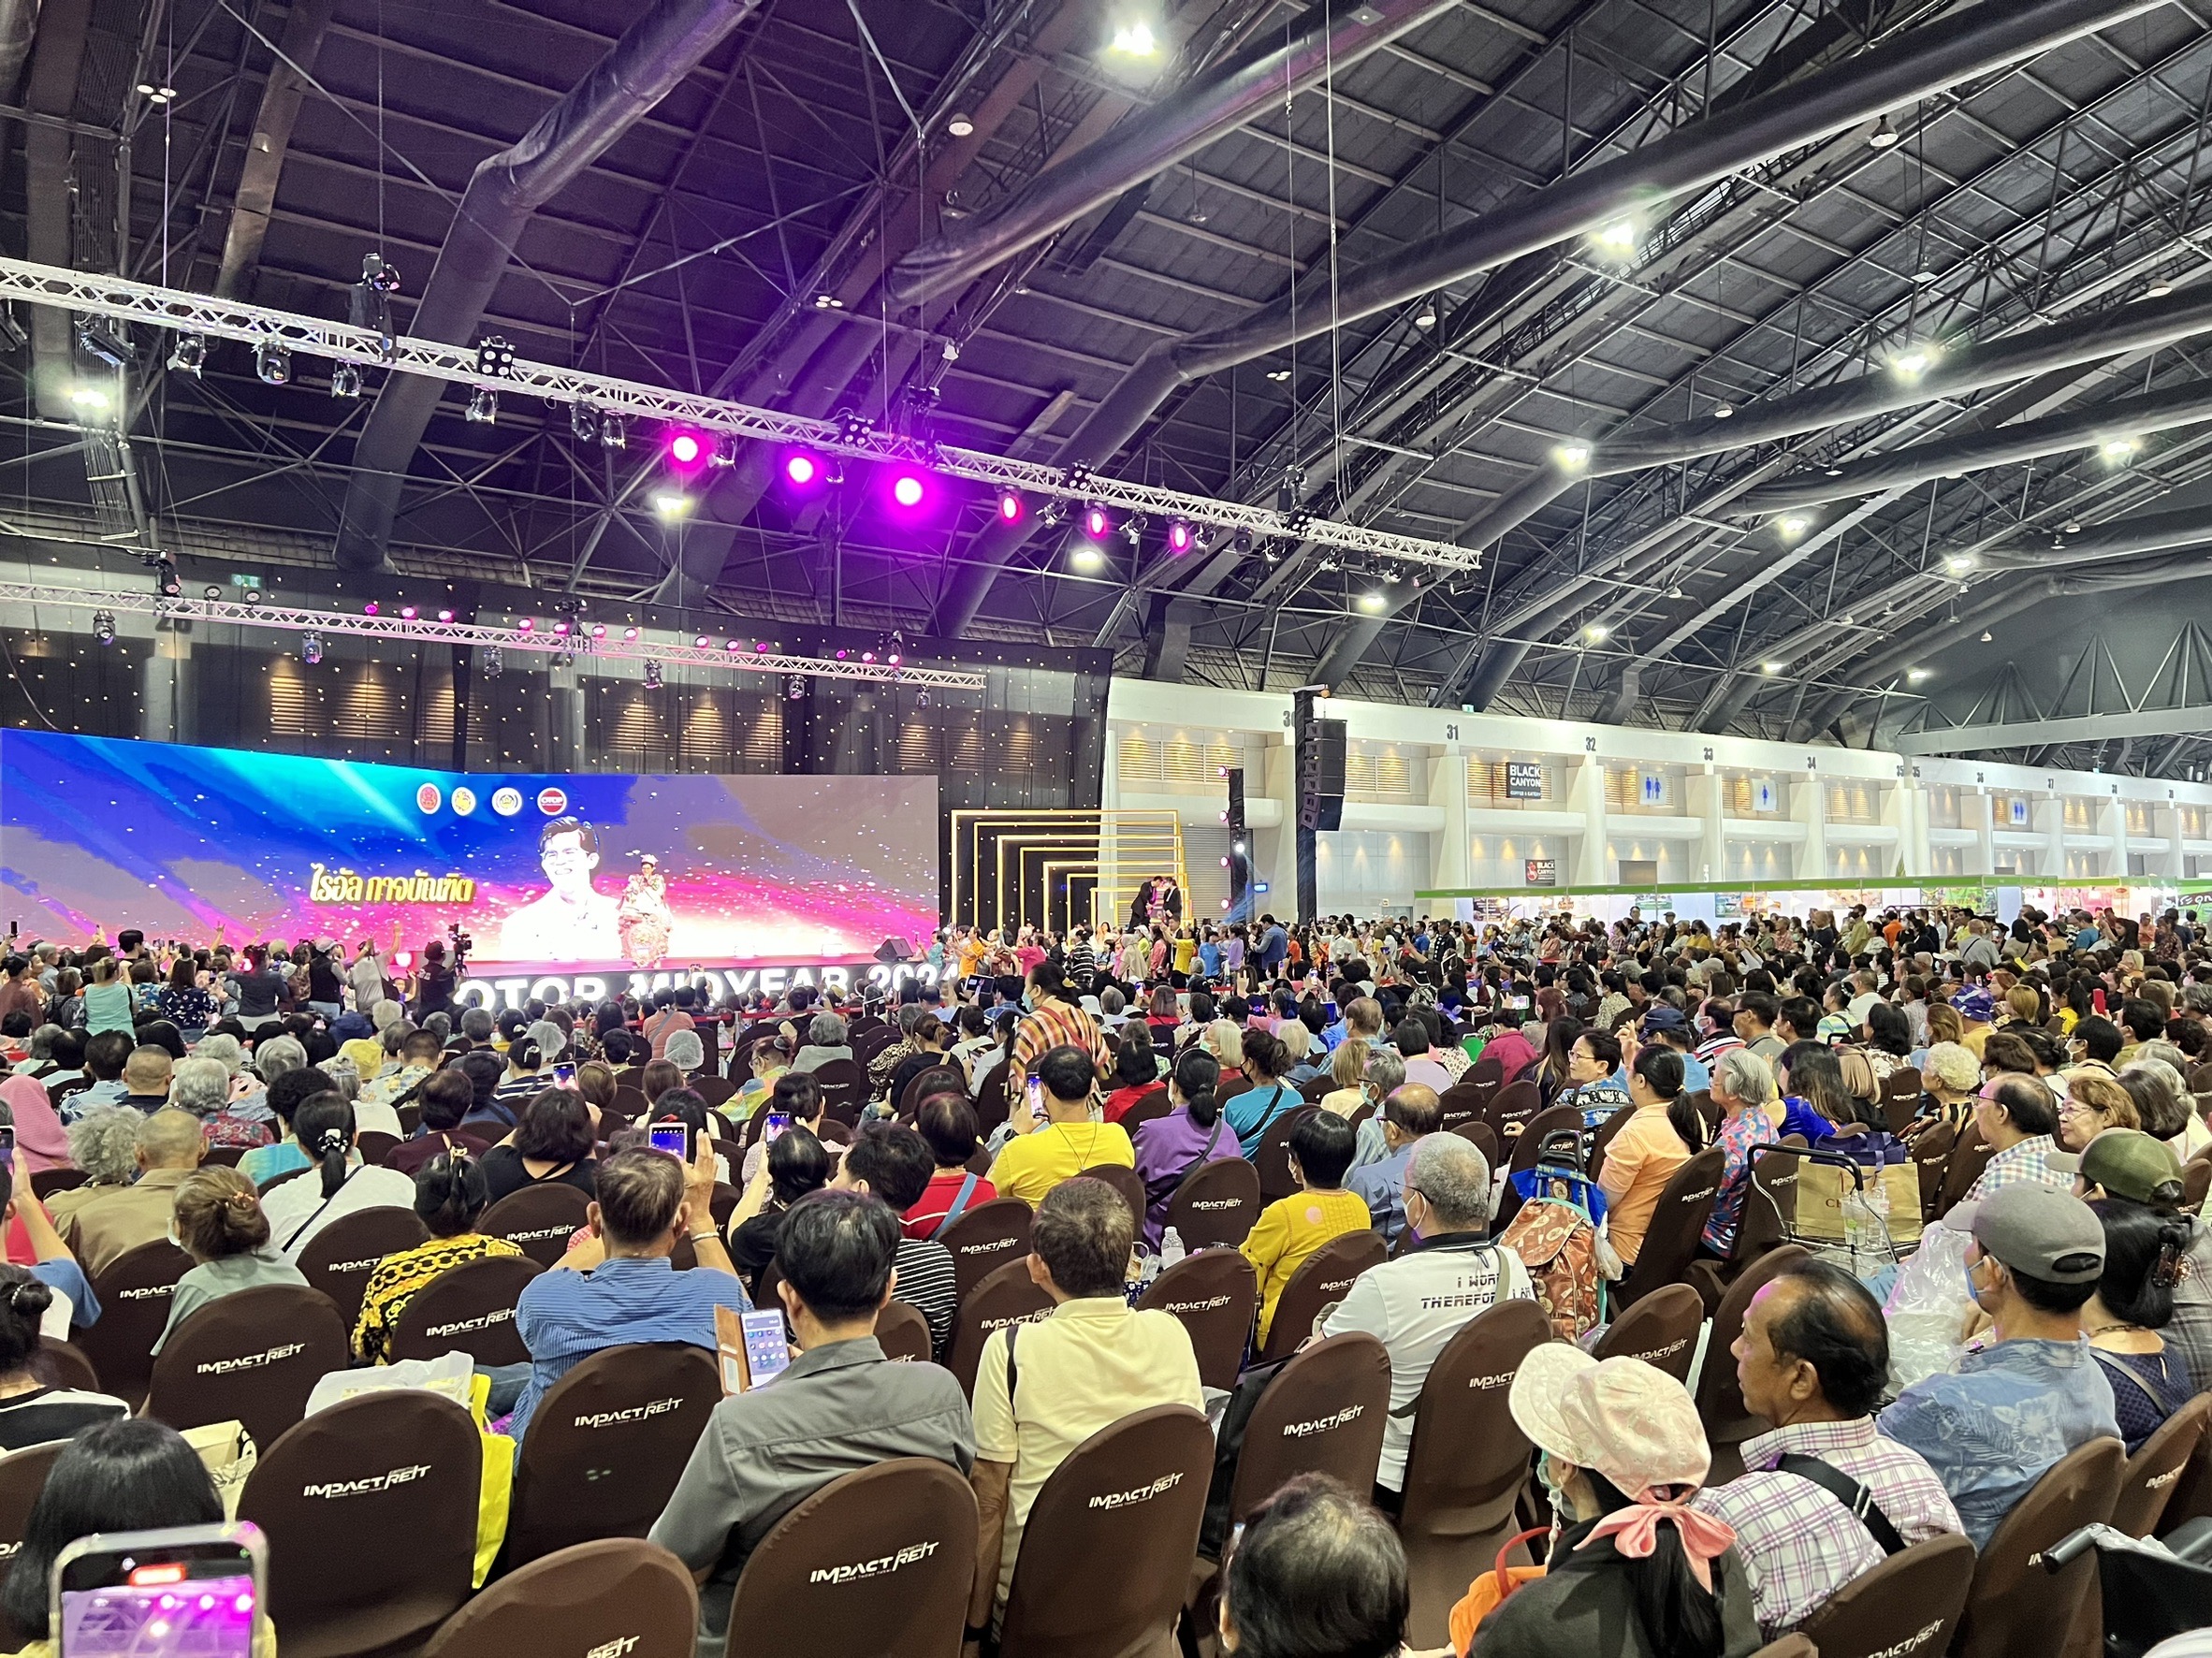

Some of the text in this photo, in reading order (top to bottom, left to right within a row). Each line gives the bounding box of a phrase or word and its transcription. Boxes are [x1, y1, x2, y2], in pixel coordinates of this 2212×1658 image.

[1447, 724, 1459, 740] 31
[1586, 736, 1596, 751] 32
[1704, 747, 1713, 761] 33
[1509, 764, 1540, 778] BLACK
[1807, 756, 1816, 770] 34
[1509, 778, 1541, 787] CANYON
[453, 976, 607, 1011] OTOP
[1192, 1200, 1226, 1211] IMPACT
[506, 1224, 575, 1242] IMPACT REIT
[961, 1237, 1018, 1255] IMPACT REIT
[329, 1258, 381, 1273] IMPACT
[120, 1284, 176, 1300] IMPACT
[1319, 1277, 1355, 1291] IMPACT
[1165, 1295, 1230, 1313] IMPACT REIT
[427, 1308, 517, 1336] IMPACT REIT
[981, 1315, 1033, 1331] IMPACT
[197, 1353, 266, 1374] IMPACT
[265, 1344, 305, 1364] REIT
[1469, 1372, 1515, 1389] IMPACT
[575, 1406, 645, 1429] IMPACT
[643, 1397, 683, 1420] REIT
[1283, 1404, 1364, 1437] IMPACT REIT
[303, 1476, 386, 1498] IMPACT
[384, 1464, 431, 1490] REIT
[1088, 1486, 1152, 1509] IMPACT
[1148, 1473, 1184, 1499] REIT
[809, 1541, 939, 1584] IMPACT REIT
